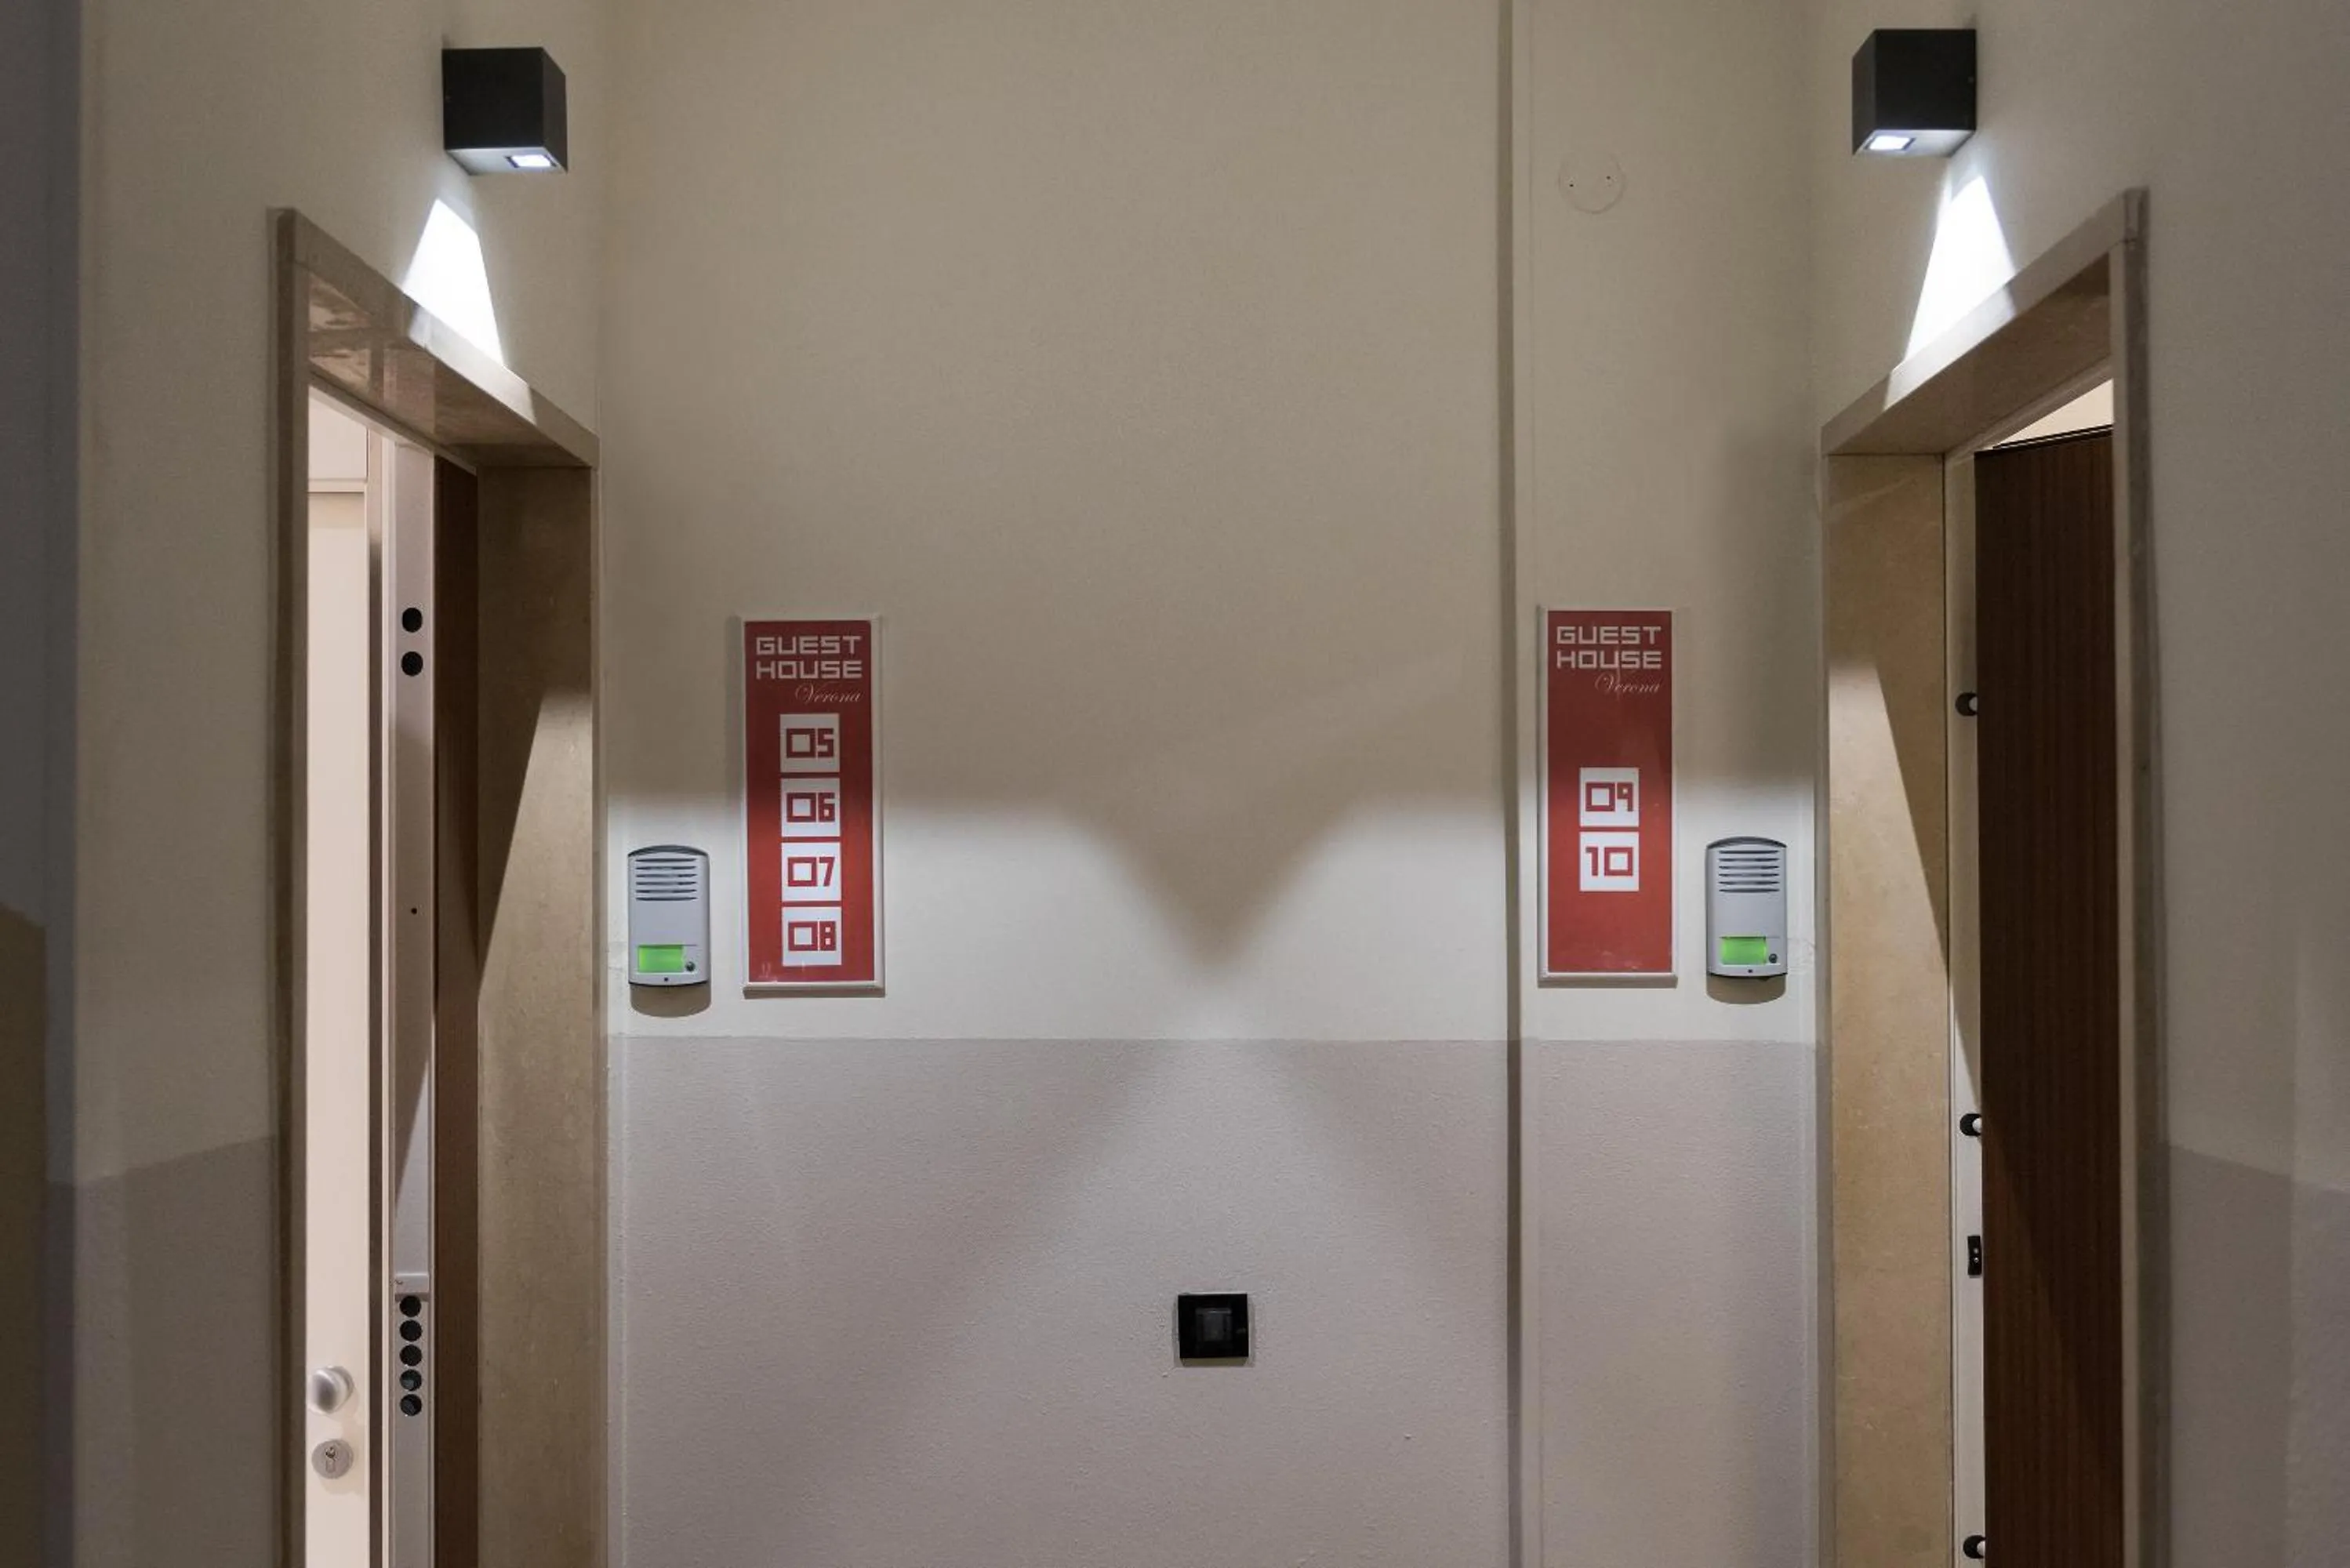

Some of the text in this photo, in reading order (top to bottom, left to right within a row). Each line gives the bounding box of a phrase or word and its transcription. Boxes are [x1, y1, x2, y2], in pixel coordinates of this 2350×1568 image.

[756, 636, 861, 655] GUEST
[1556, 626, 1662, 644] GUEST
[756, 659, 863, 680] HOUSE
[1556, 650, 1662, 669] HOUSE
[794, 681, 864, 704] Verona
[1594, 671, 1662, 694] Verona
[786, 728, 834, 758] 05
[786, 793, 835, 822] 06
[1585, 782, 1633, 812] 09
[787, 856, 836, 887] 07
[1585, 847, 1633, 877] 10
[788, 921, 837, 951] 08
